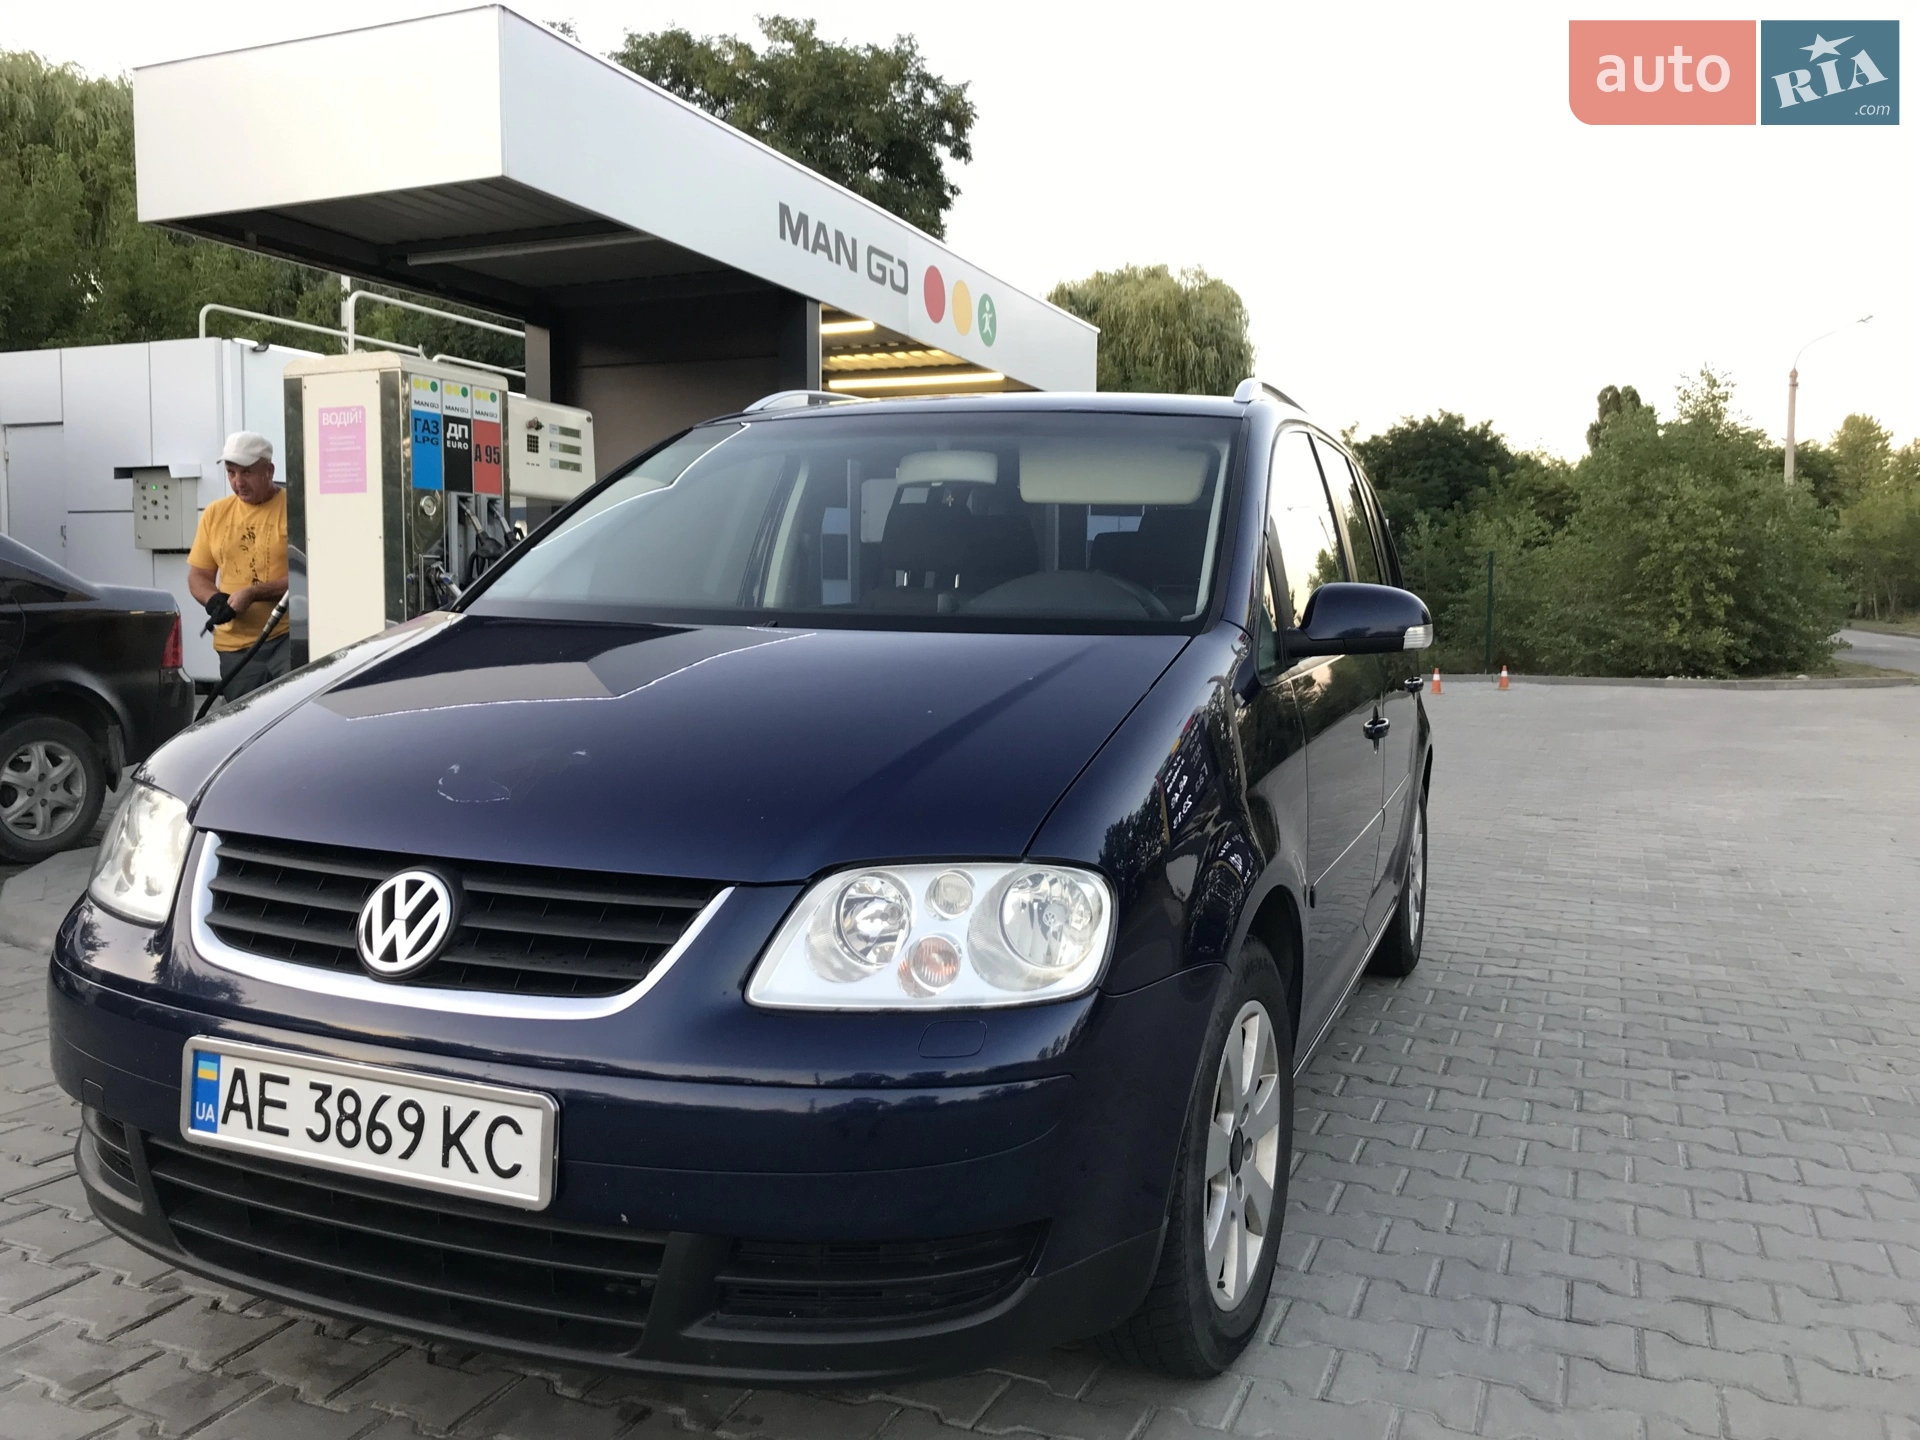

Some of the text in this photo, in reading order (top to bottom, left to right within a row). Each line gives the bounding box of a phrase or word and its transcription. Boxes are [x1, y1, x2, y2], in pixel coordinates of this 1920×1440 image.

[322, 407, 362, 427] ВОДІЙ!
[414, 417, 440, 435] ГАЗ
[414, 435, 439, 446] LPG
[446, 422, 469, 440] ДП
[446, 440, 469, 450] EURO
[485, 445, 500, 465] 95
[195, 1101, 216, 1124] UA
[221, 1066, 523, 1179] AE 3869 KC
